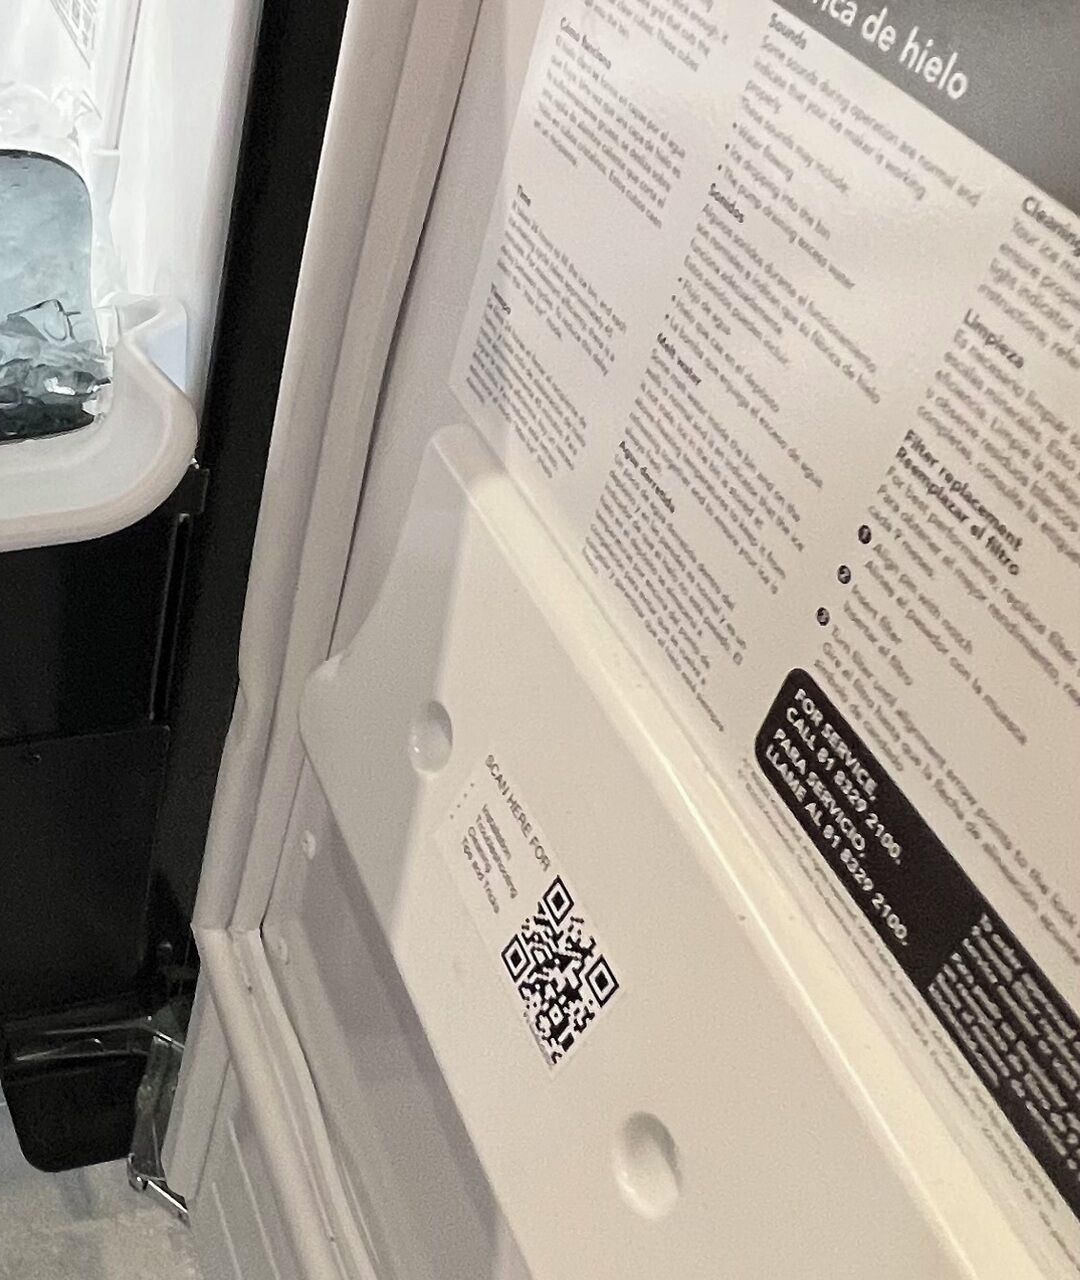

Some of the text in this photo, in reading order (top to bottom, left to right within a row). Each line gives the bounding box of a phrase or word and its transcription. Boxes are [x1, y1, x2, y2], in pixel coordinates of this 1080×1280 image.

[768, 12, 807, 50] Sounds
[785, 57, 818, 86] sounds
[861, 7, 896, 52] de
[899, 26, 968, 100] hielo
[708, 183, 745, 223] Sonidos
[885, 160, 927, 201] working
[895, 446, 1019, 576] Reemplazar el filtro
[904, 429, 1023, 552] Filter replacement
[485, 754, 510, 796] SCAN
[506, 793, 532, 838] HERE
[773, 728, 865, 857] PARA SERVICIO,
[786, 707, 816, 751] CALL
[865, 813, 901, 864] 2100.
[794, 688, 877, 801] FOR SERVICE,
[766, 744, 807, 802] LLAME
[804, 803, 823, 827] AL
[872, 893, 907, 946] 2100.
